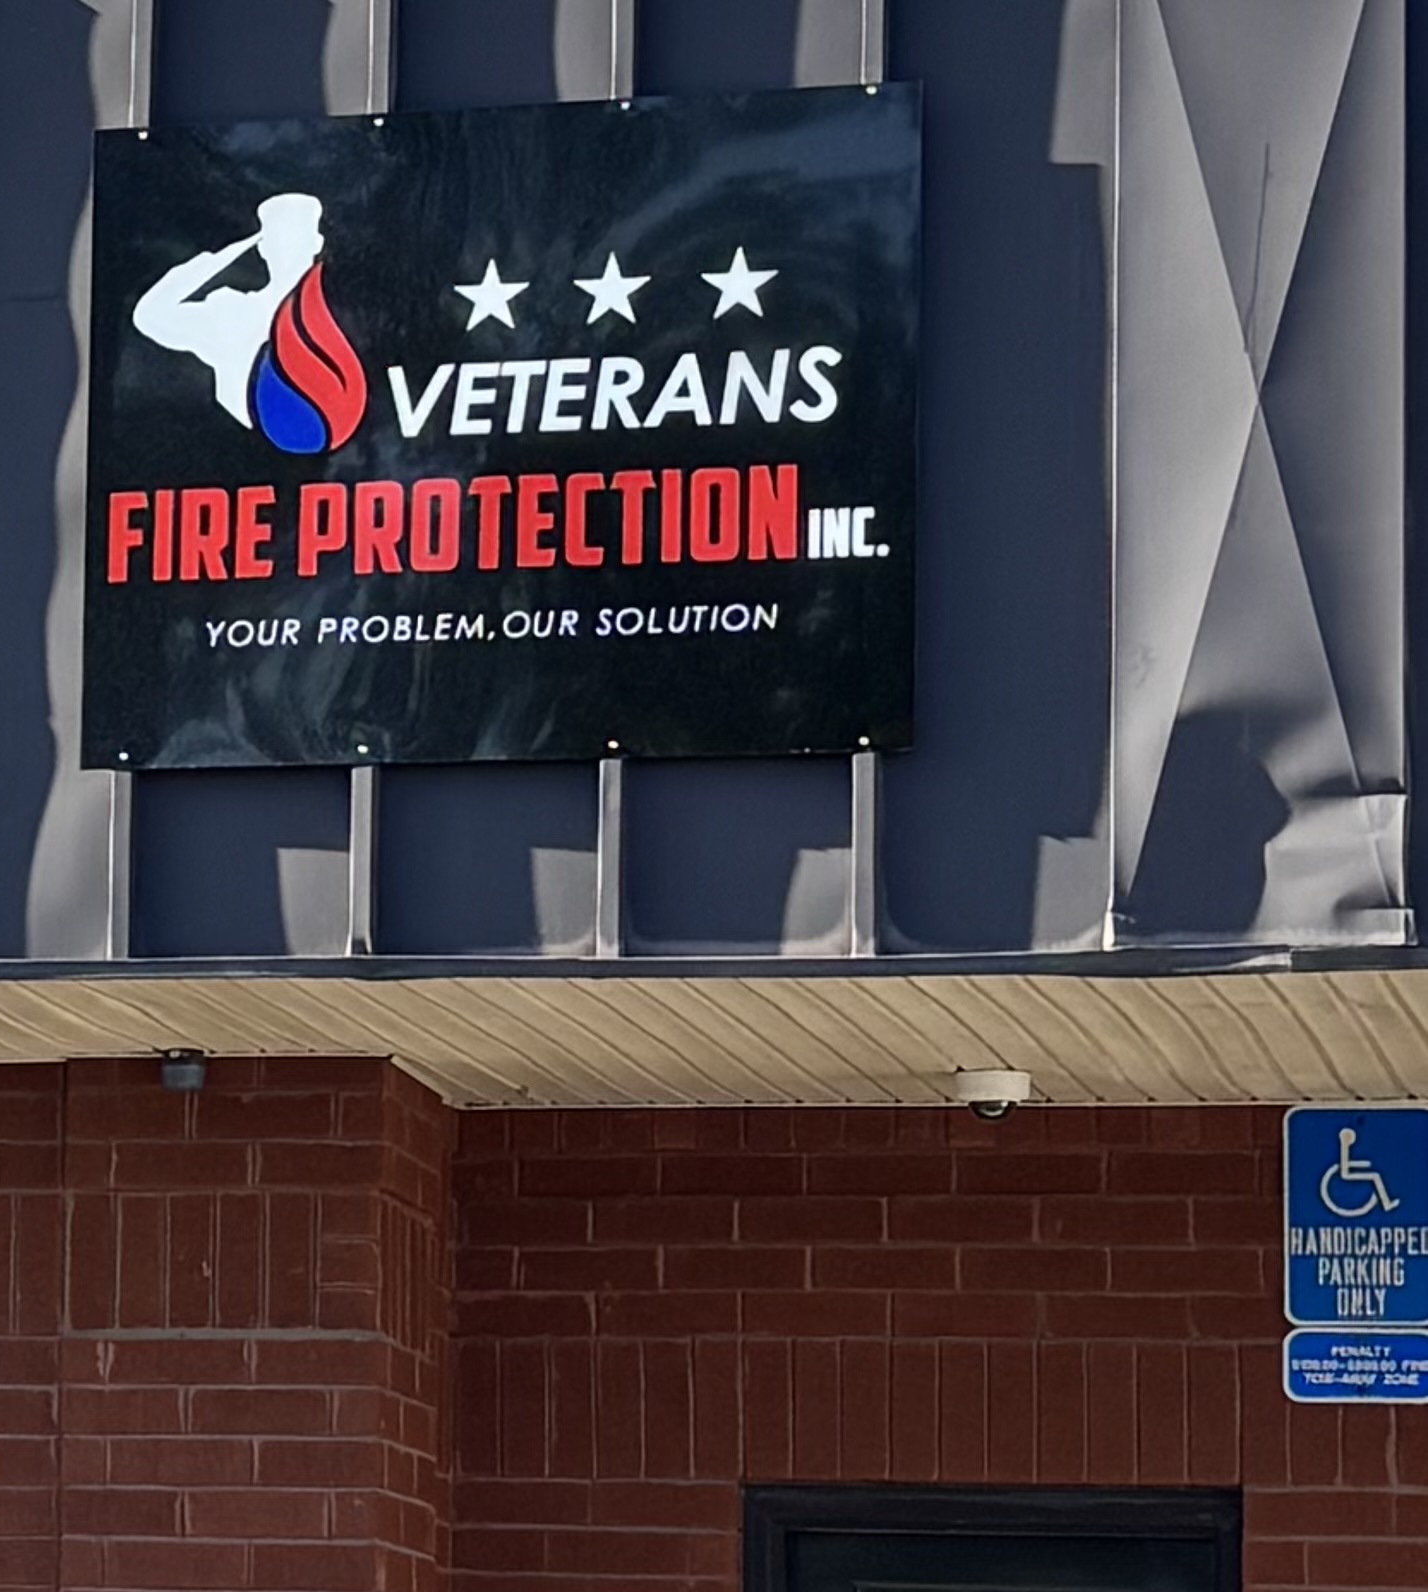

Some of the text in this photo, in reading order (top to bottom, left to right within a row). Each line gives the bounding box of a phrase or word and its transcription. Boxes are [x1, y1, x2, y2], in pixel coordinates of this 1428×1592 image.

[387, 345, 843, 438] VETERANS
[107, 463, 891, 583] FIRE PROTECTION INC.
[205, 617, 301, 649] YOUR
[503, 607, 580, 641] OUR
[595, 602, 780, 637] SOLUTION
[1318, 1257, 1405, 1287] PARKING
[1336, 1288, 1388, 1317] ONLY
